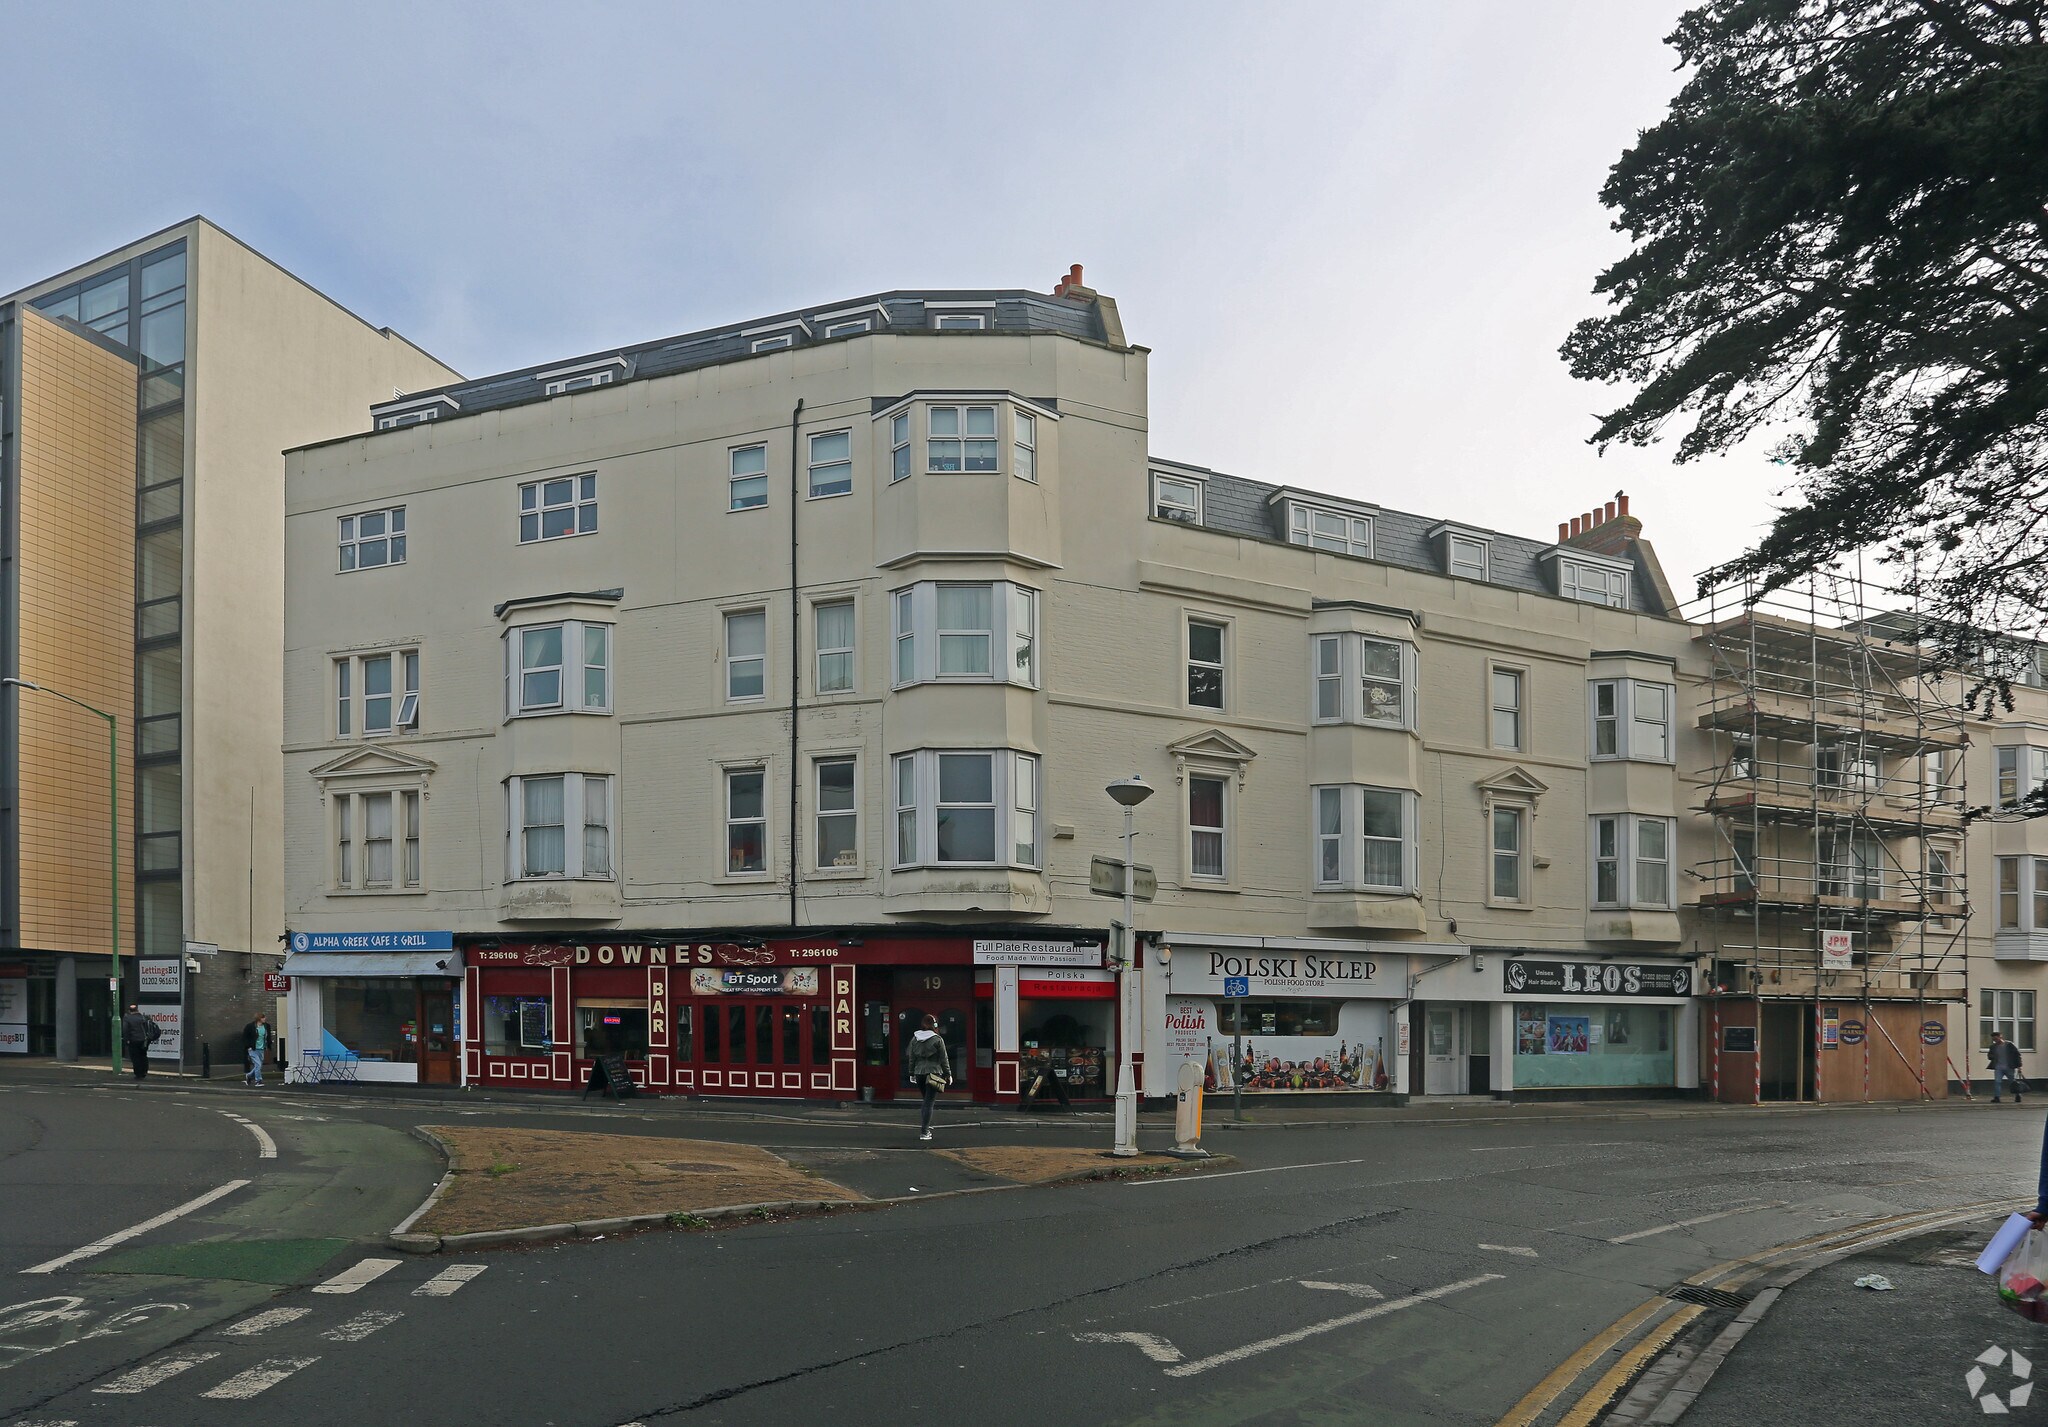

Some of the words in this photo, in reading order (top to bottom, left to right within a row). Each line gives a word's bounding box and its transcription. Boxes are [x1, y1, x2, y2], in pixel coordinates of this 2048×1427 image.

[313, 937, 339, 947] ALPHA
[342, 936, 368, 947] GREEK
[370, 935, 390, 946] CAFE
[401, 935, 427, 946] GRILL
[1827, 936, 1848, 946] JPM
[790, 949, 799, 957] T:
[802, 949, 838, 957] 296106
[976, 942, 993, 951] Full
[996, 942, 1021, 952] Plate
[1022, 942, 1082, 953] Restaurant
[489, 952, 518, 960] 296106
[575, 945, 713, 964] DOWNES
[142, 966, 178, 977] LettingsBU
[1208, 952, 1297, 977] POLSKI
[1304, 955, 1377, 980] SKLEP
[728, 975, 746, 984] BT
[746, 974, 778, 985] Sport
[1047, 971, 1085, 979] Polska
[1561, 964, 1642, 993] LEOS
[142, 977, 158, 985] 01202
[923, 976, 941, 990] 19
[1264, 978, 1286, 986] POLISH
[1305, 979, 1325, 987] STORE
[1034, 983, 1101, 993] Restauracja
[1504, 984, 1512, 992] 15
[652, 982, 664, 1033] BAR
[836, 980, 850, 1034] BAR
[1180, 1006, 1192, 1014] BEST
[143, 1012, 178, 1022] ndlords
[1165, 1013, 1205, 1029] Polish
[0, 1031, 25, 1044] ingsBU
